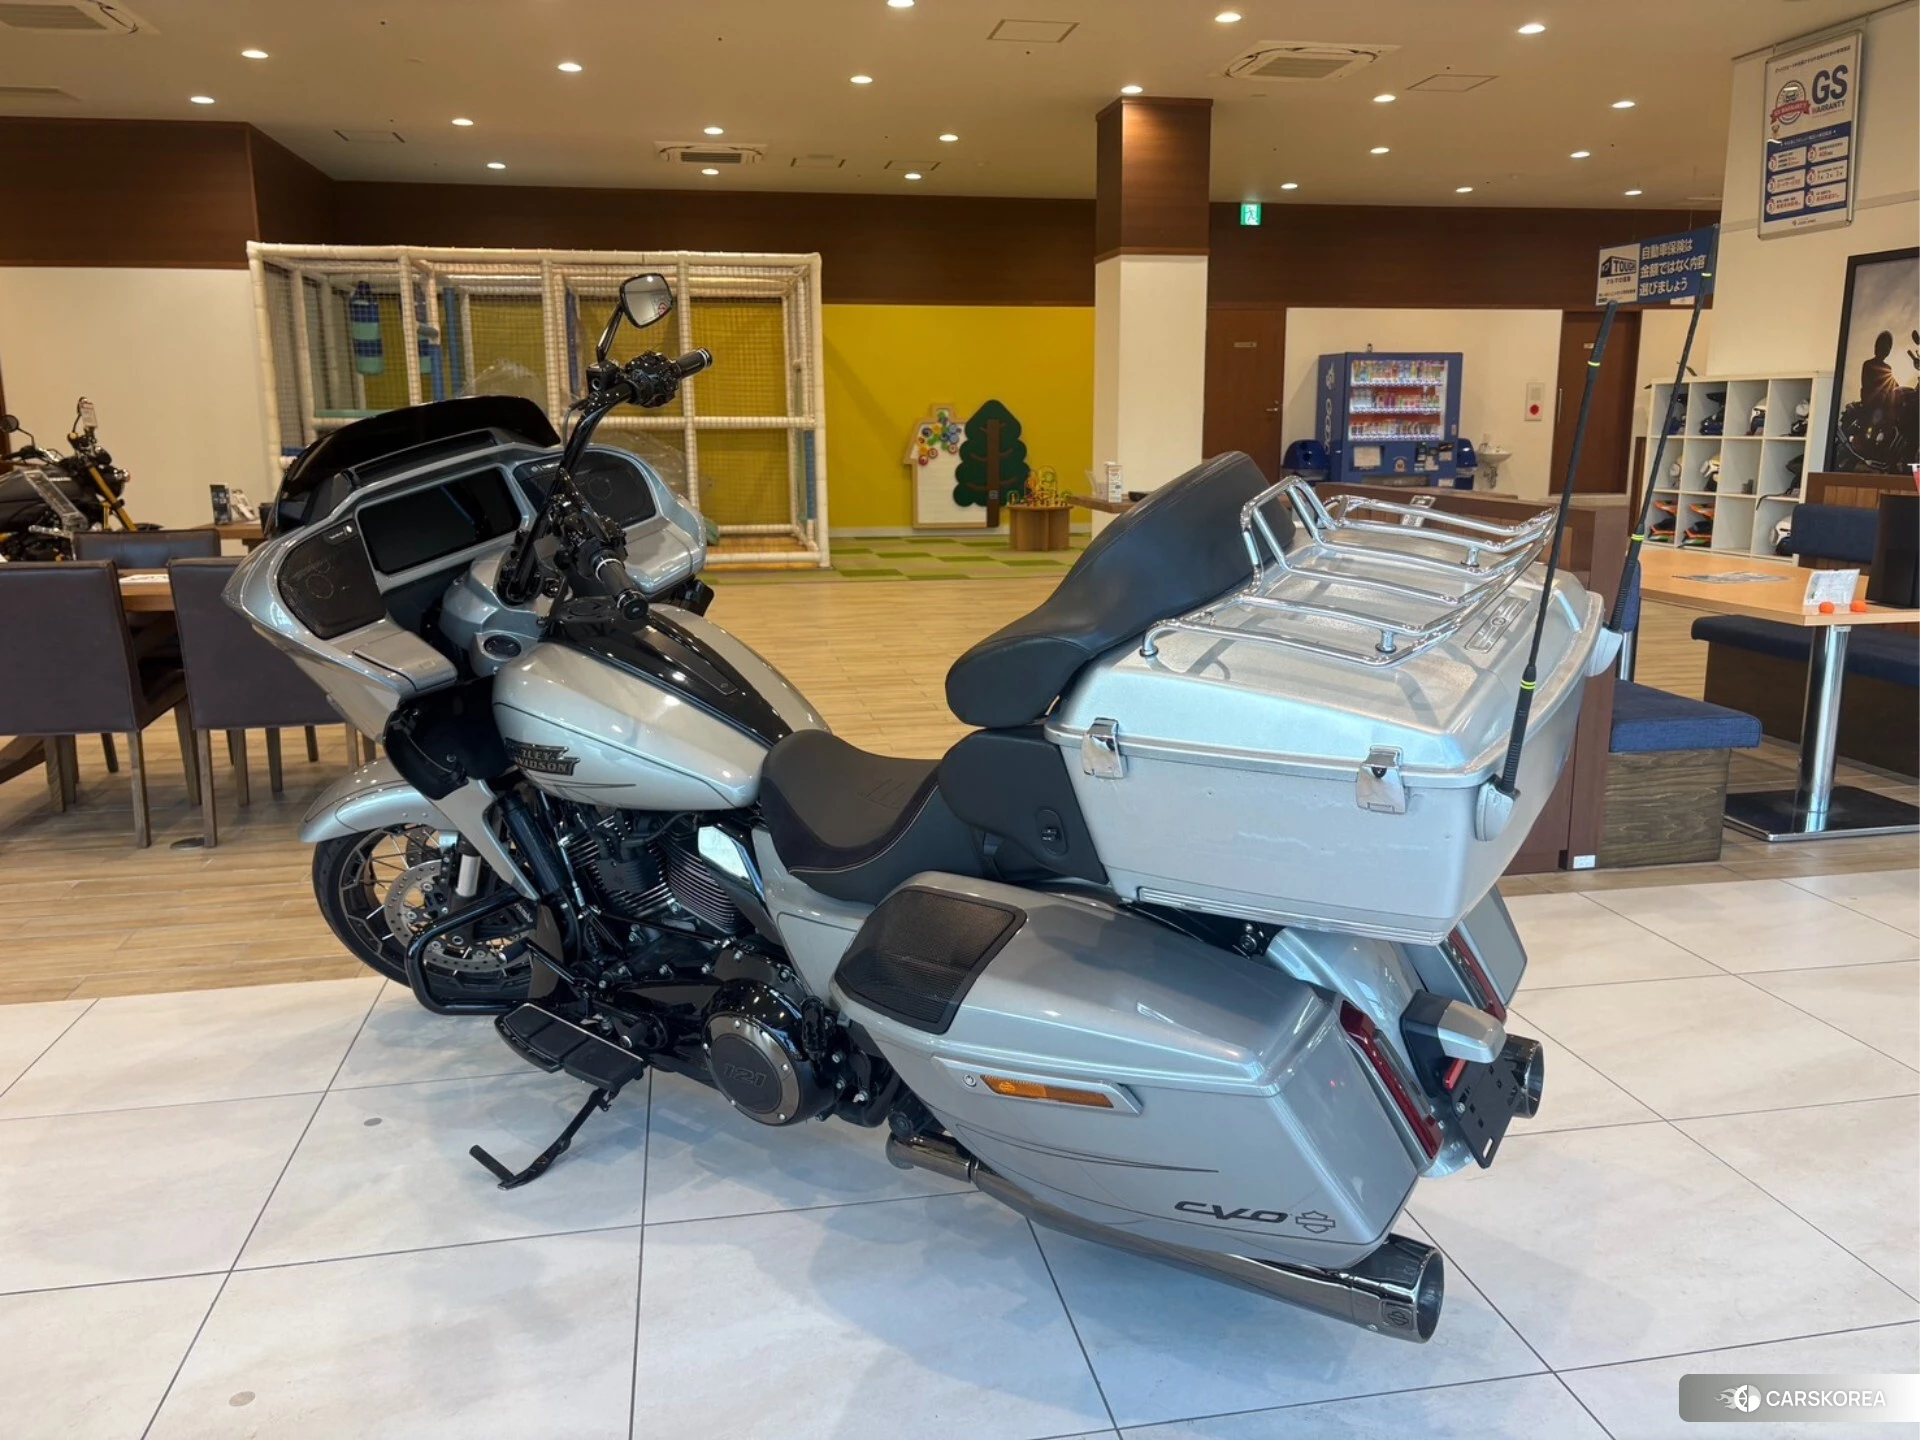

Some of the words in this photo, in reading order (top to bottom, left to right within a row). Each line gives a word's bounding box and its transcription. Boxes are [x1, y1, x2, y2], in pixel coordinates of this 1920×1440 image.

[1811, 64, 1848, 105] GS
[723, 1062, 767, 1088] 121
[1174, 1200, 1289, 1224] CVO
